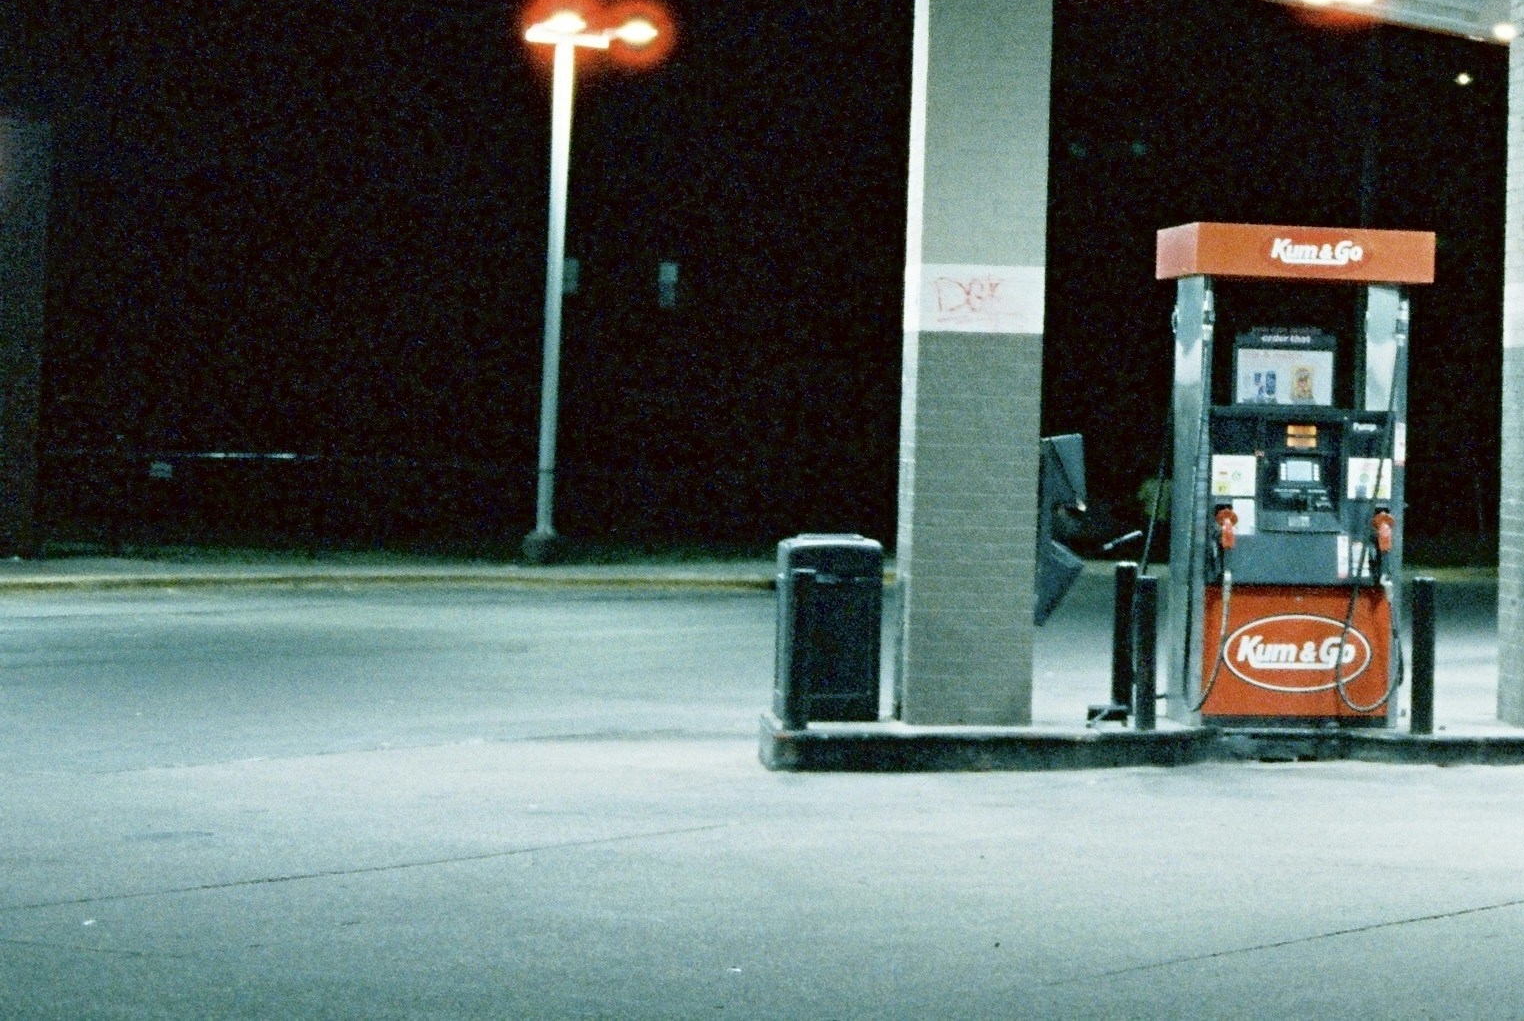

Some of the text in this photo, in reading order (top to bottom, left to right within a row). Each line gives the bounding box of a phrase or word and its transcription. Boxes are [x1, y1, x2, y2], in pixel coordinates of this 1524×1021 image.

[1270, 238, 1364, 265] Kum & Go
[1236, 635, 1356, 669] Kum & Go
